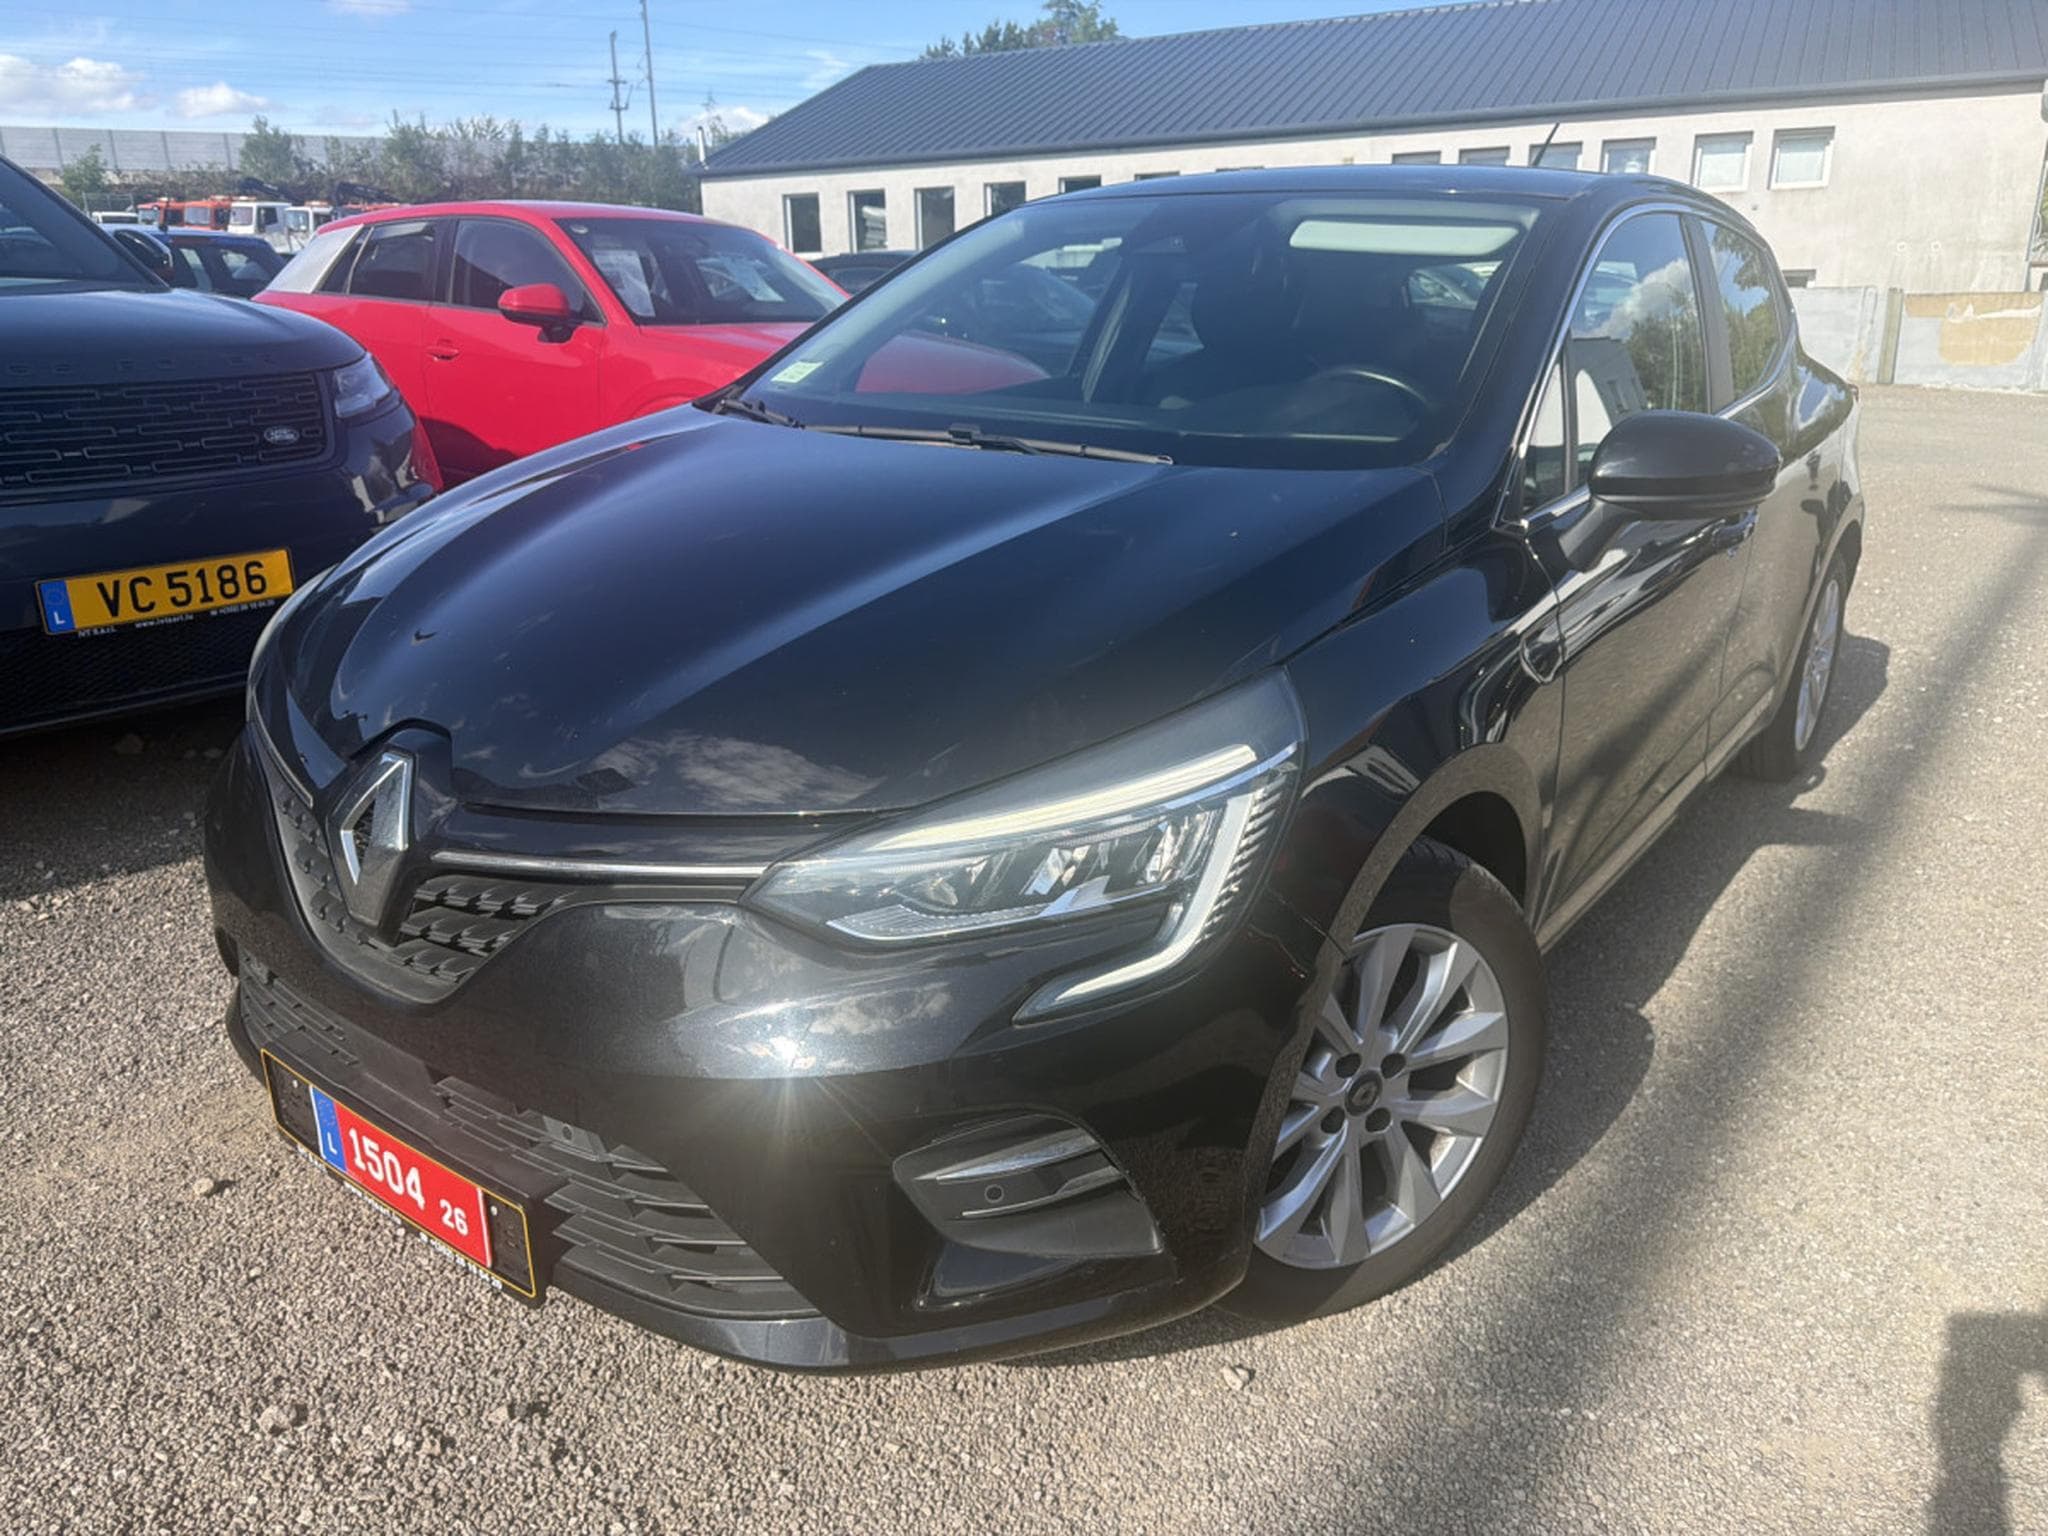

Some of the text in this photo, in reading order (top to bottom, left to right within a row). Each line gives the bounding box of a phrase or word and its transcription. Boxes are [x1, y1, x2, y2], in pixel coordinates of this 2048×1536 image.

[97, 560, 267, 617] VC 5186
[54, 612, 65, 625] L
[327, 1132, 338, 1155] L
[349, 1127, 425, 1211] 1504
[440, 1199, 469, 1237] 26
